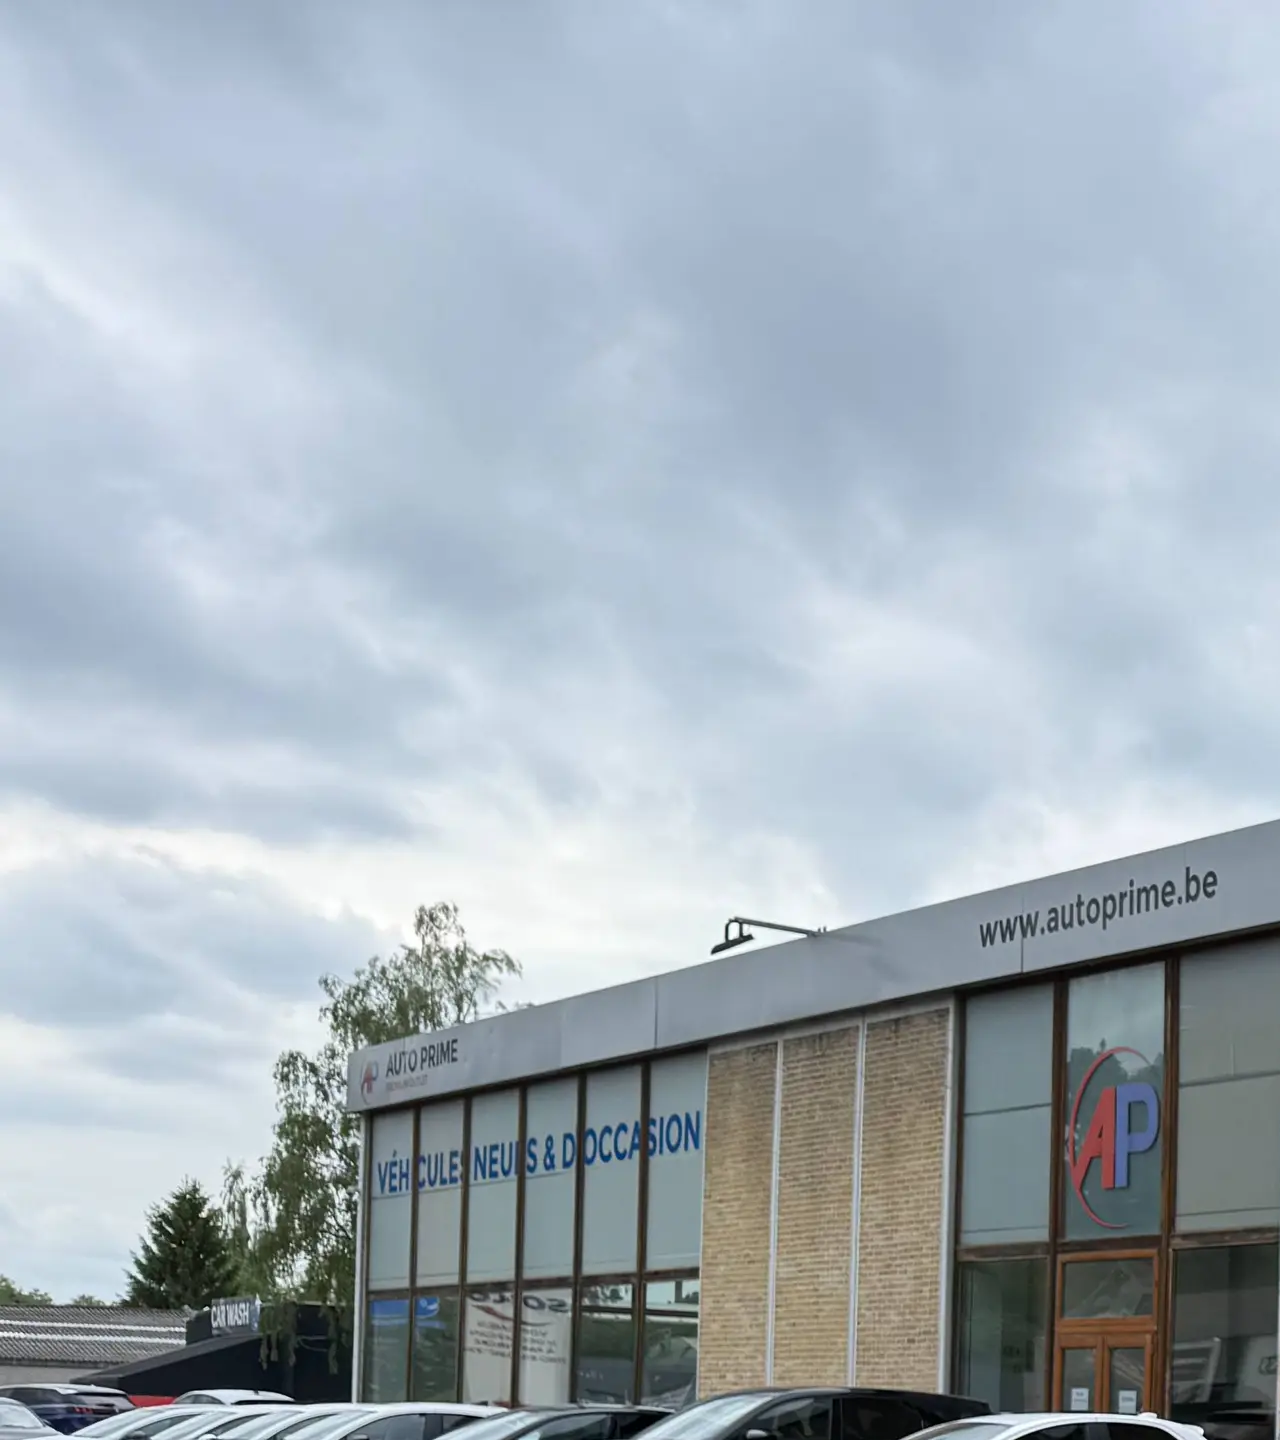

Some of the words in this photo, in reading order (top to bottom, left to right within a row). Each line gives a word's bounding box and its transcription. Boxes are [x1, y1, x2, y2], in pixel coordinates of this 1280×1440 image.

[979, 866, 1219, 948] www.autoprime.be
[386, 1049, 418, 1077] AUTO
[421, 1039, 459, 1070] PRIME
[543, 1134, 556, 1171] &
[562, 1111, 701, 1169] DOCCASION
[1071, 1082, 1159, 1189] AP
[211, 1305, 226, 1328] CAR
[226, 1302, 250, 1326] WASH
